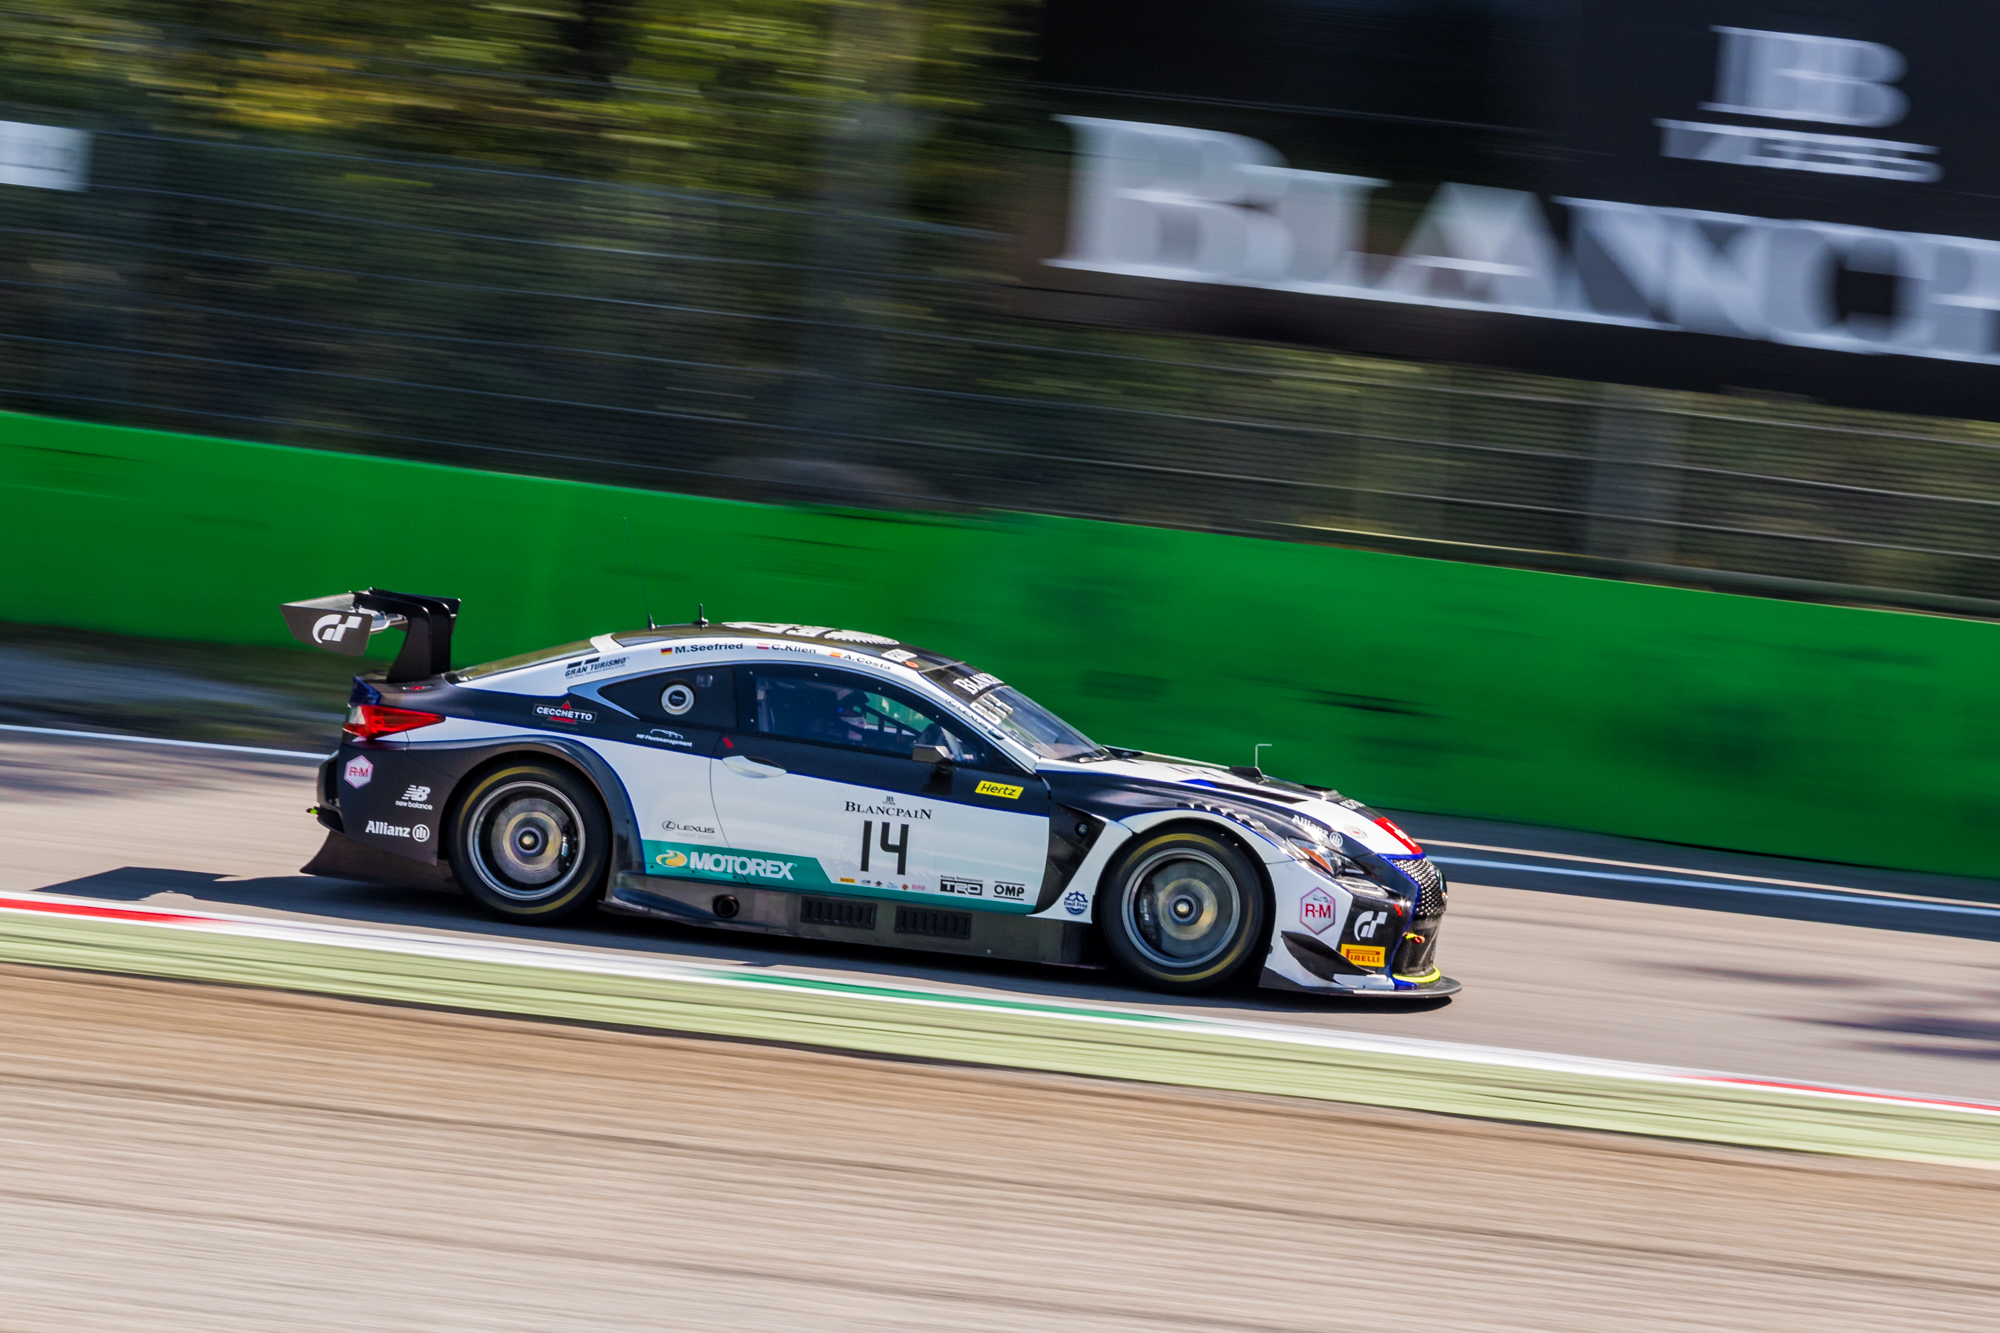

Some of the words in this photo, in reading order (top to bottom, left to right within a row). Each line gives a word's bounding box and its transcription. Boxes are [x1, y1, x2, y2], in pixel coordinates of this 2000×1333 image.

[675, 643, 743, 653] M.Seefried
[771, 644, 817, 654] C.Klien
[565, 666, 588, 677] GRAN
[590, 657, 627, 671] TURISMO
[843, 654, 891, 670] A.Costa
[536, 706, 593, 721] CECCHETTO
[980, 783, 1016, 796] Hertz
[408, 801, 433, 810] balance
[844, 801, 932, 820] BLANCPAIN
[365, 820, 411, 838] Allianz
[677, 823, 715, 834] LEXUS
[861, 820, 909, 876] 14
[689, 851, 795, 881] MOTOREX
[941, 880, 982, 896] TRD
[993, 884, 1025, 898] OMP
[1305, 903, 1331, 919] R-M
[1345, 948, 1381, 963] PIRELLI
